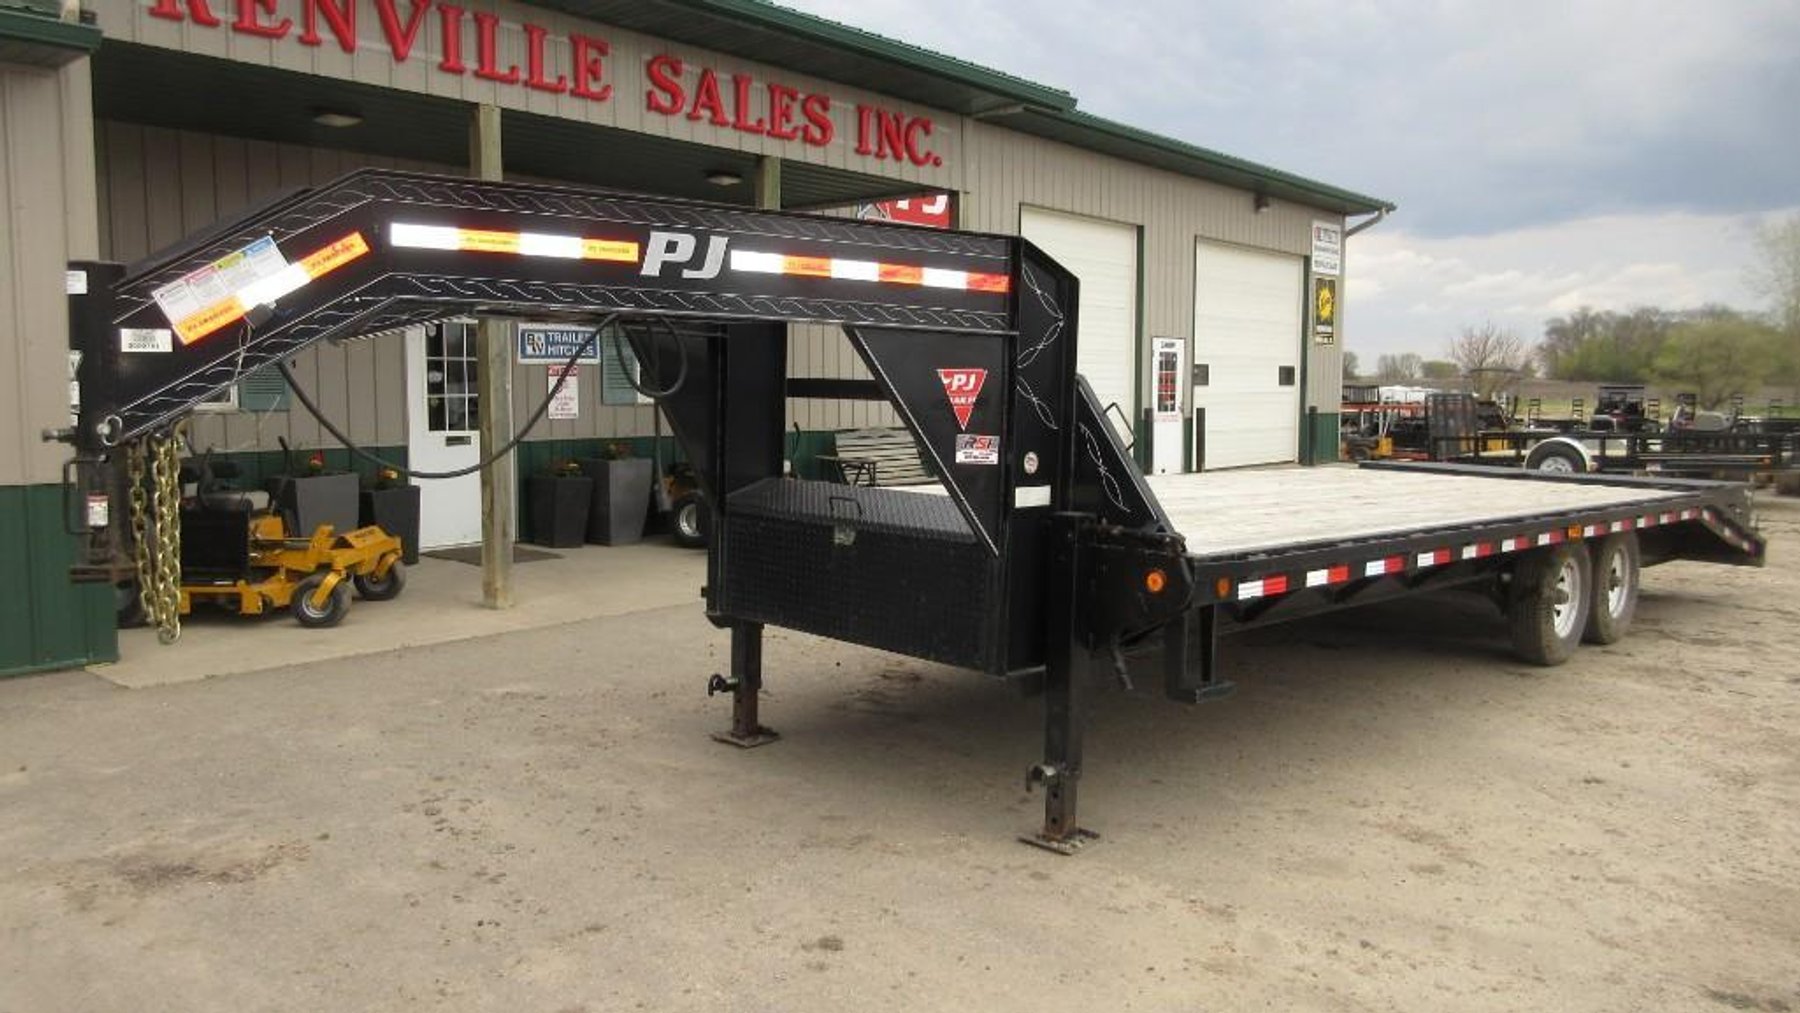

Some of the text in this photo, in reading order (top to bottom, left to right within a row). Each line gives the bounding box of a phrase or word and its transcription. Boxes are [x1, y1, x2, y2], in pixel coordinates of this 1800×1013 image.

[646, 54, 834, 147] SALES
[855, 104, 943, 169] INC.
[641, 231, 729, 279] PJ
[950, 373, 977, 391] PJ
